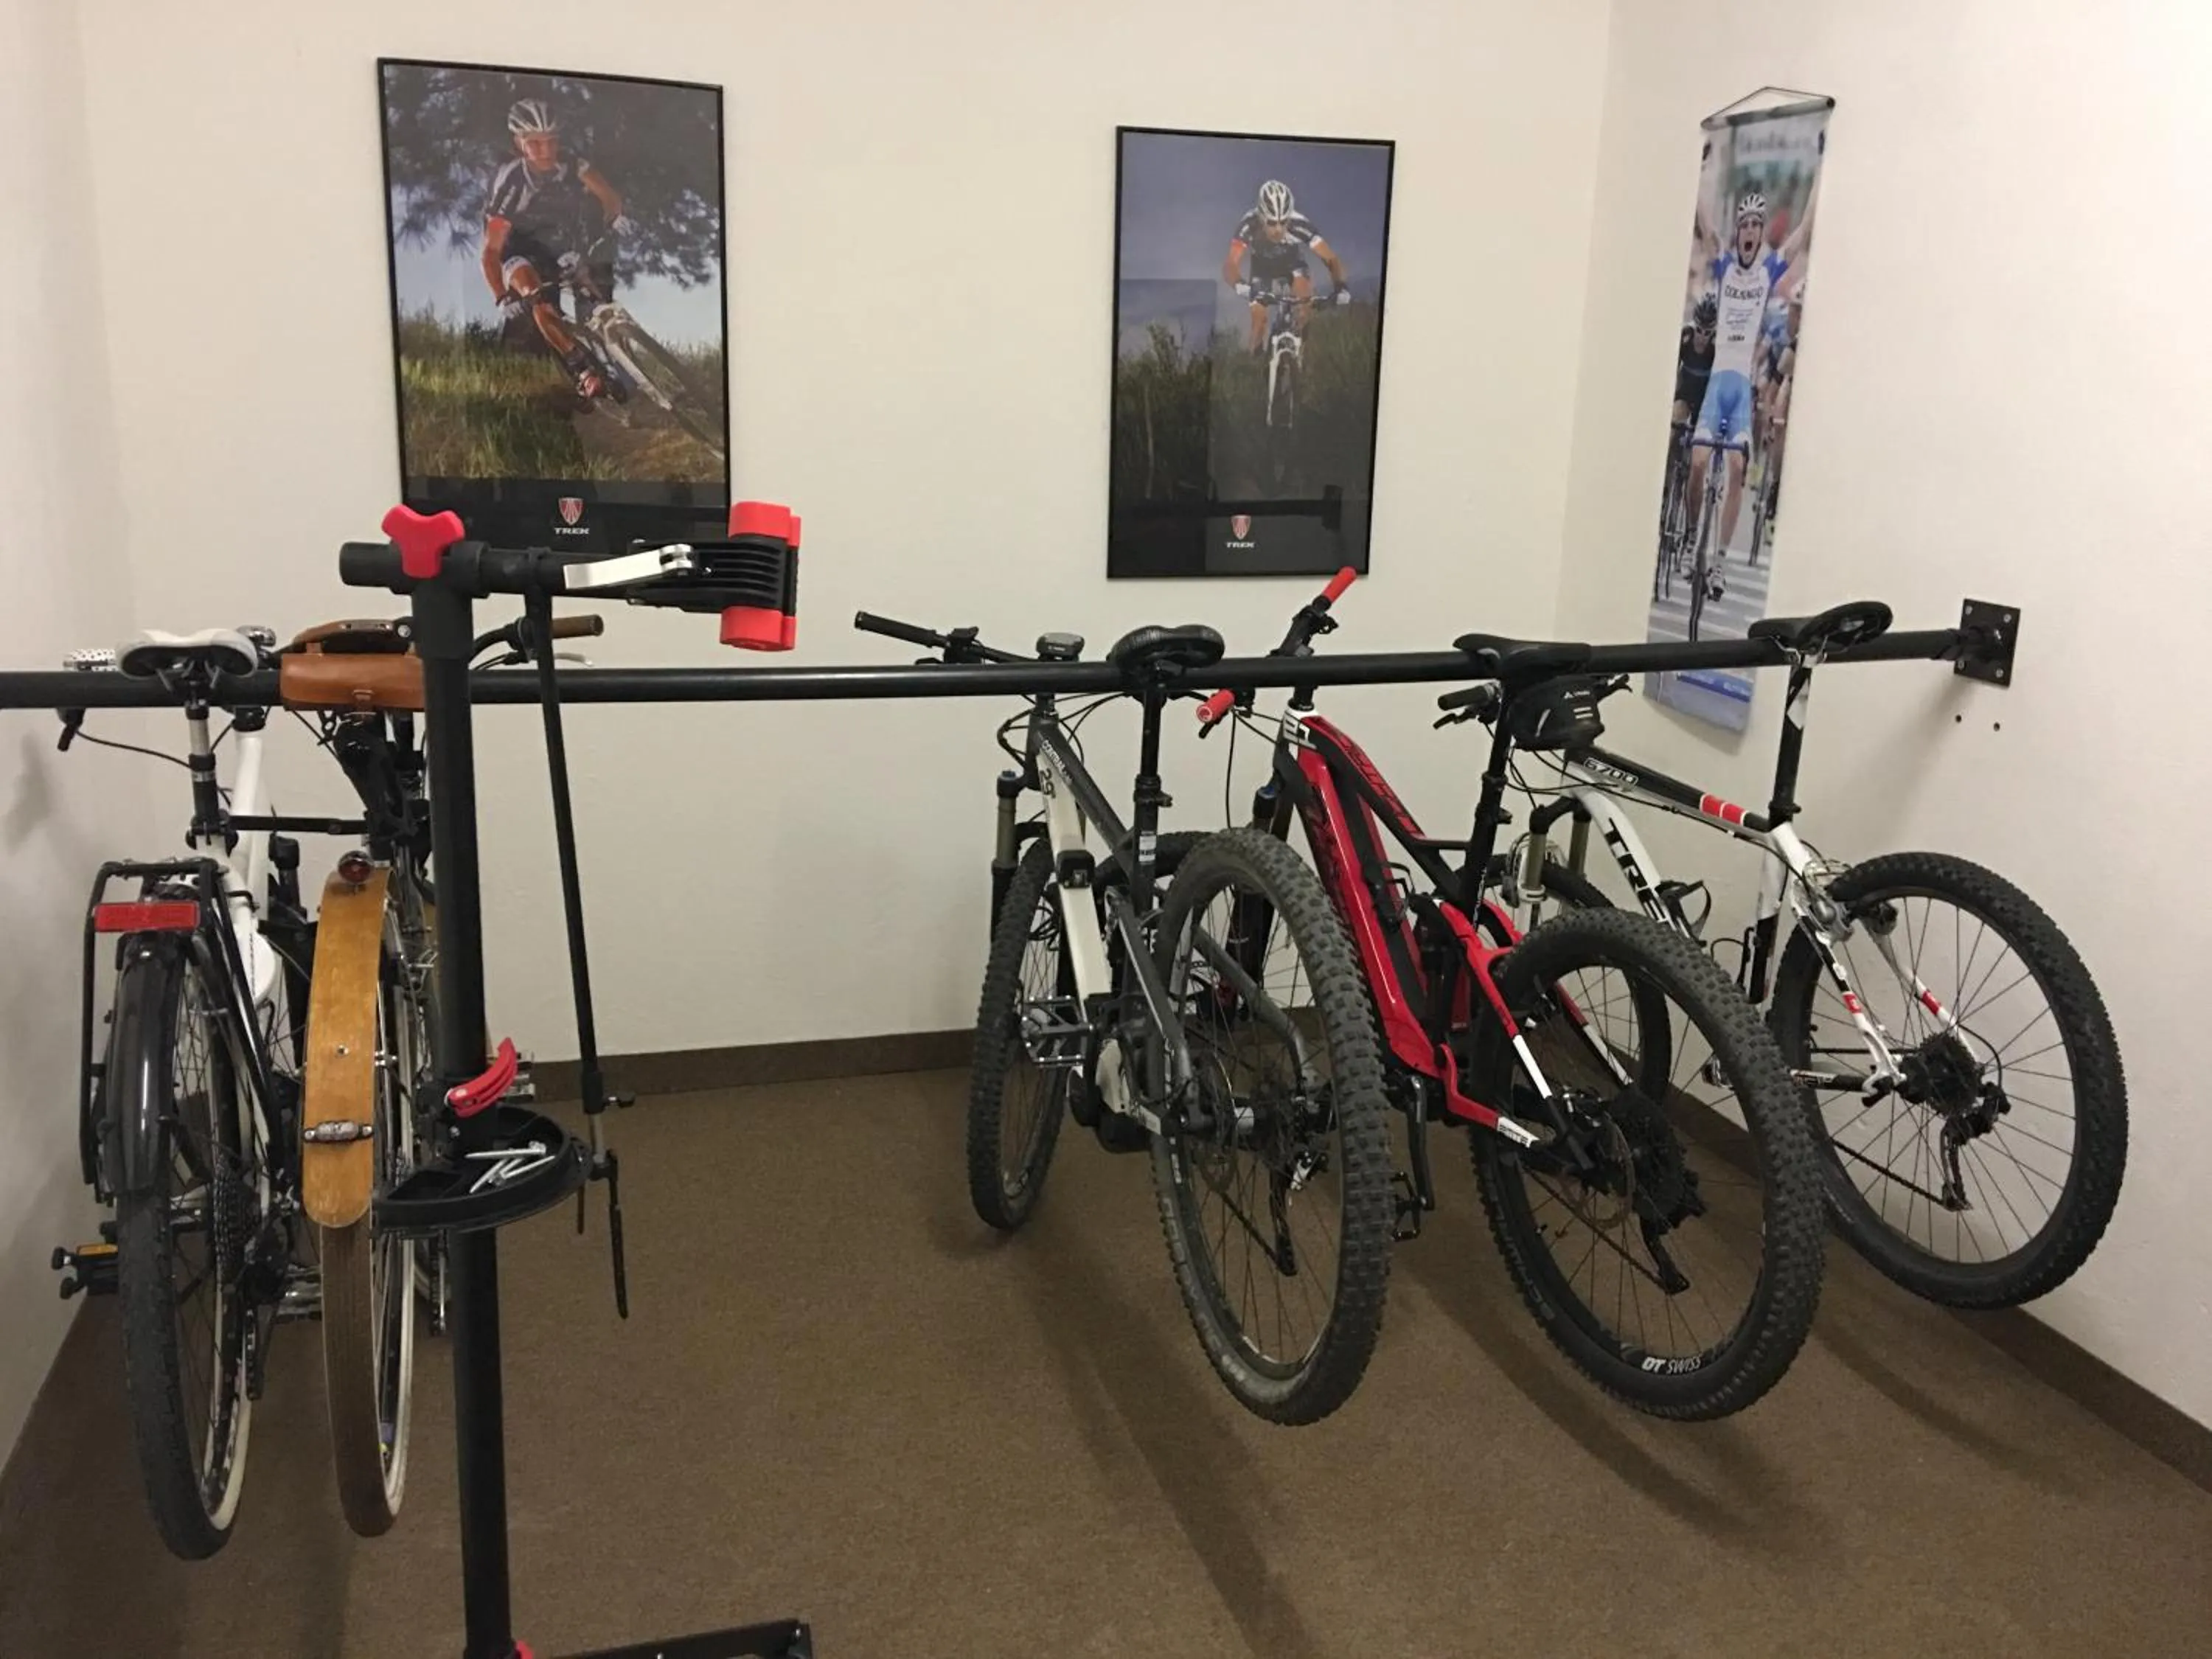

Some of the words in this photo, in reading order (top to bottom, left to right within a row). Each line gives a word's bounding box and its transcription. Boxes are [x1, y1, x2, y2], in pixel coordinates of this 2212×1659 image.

[1604, 817, 1668, 922] TRE
[1641, 1356, 1666, 1373] DT
[1666, 1355, 1702, 1374] SWISS
